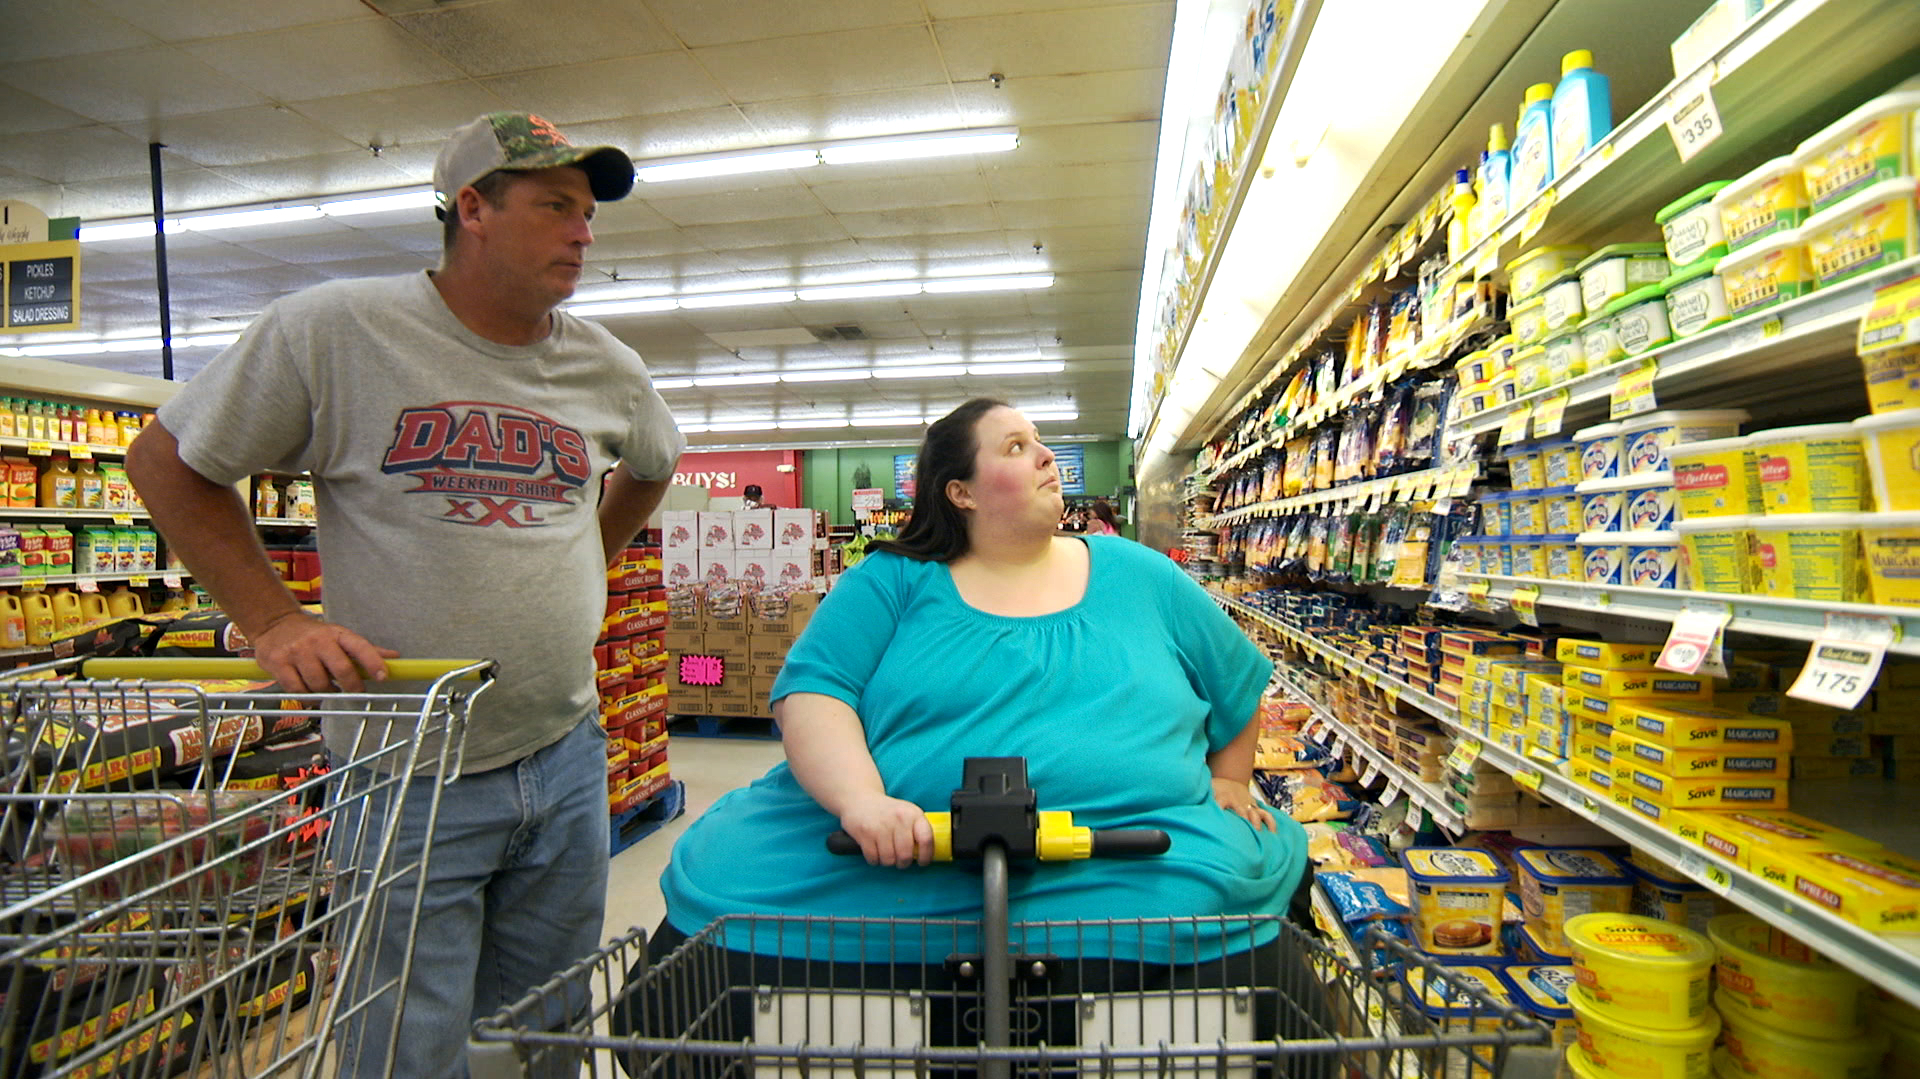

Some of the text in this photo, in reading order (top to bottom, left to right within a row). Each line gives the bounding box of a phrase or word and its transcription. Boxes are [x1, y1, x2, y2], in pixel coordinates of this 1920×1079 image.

[26, 263, 55, 278] PICKLES
[24, 285, 56, 300] KETCHUP
[13, 306, 69, 322] SALAD DRESSING
[381, 408, 592, 487] DAD'S
[432, 475, 558, 499] WEEKEND SHIRT
[672, 471, 736, 489] BUYS!
[443, 498, 545, 528] XXL
[624, 573, 659, 587] CLASSIC ROAST
[627, 615, 665, 631] CLASSIC ROAST
[1621, 652, 1645, 663] Save
[751, 665, 756, 675] 2
[1623, 680, 1648, 691] Save
[624, 698, 664, 721] CLASSIC ROAST
[708, 704, 713, 713] 2
[753, 705, 758, 715] 2
[1689, 728, 1777, 741] Save MARGARINE
[1690, 758, 1774, 771] Save MARGARINE
[628, 789, 649, 806] CLASSIC
[1687, 788, 1772, 801] Save MARGARINE
[1679, 826, 1737, 857] Save SPREAD
[1762, 866, 1841, 908] Save SPREAD
[1604, 926, 1649, 934] Save
